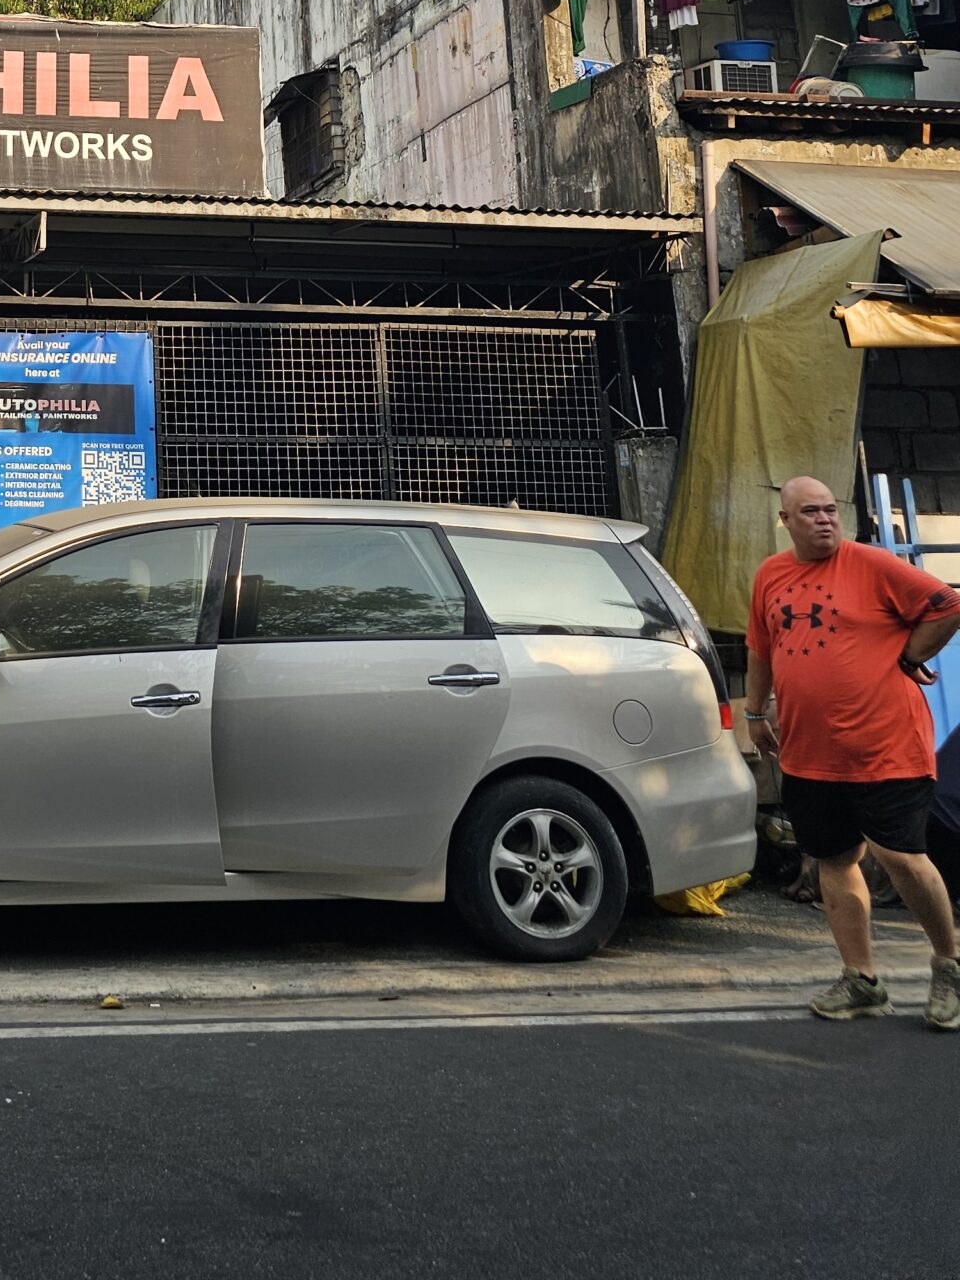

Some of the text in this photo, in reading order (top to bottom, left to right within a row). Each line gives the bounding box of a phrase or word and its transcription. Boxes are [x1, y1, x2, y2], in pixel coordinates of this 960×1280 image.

[17, 340, 70, 352] Avail your
[71, 353, 117, 365] ONLINE
[25, 368, 60, 378] here at
[4, 446, 53, 457] OFFERED
[5, 462, 72, 471] CERAMIC COATING
[5, 472, 63, 480] EXTERIOR DETAIL
[5, 481, 37, 489] INTERIOR
[29, 491, 65, 499] CLEANING
[4, 500, 45, 508] DEGRIMING
